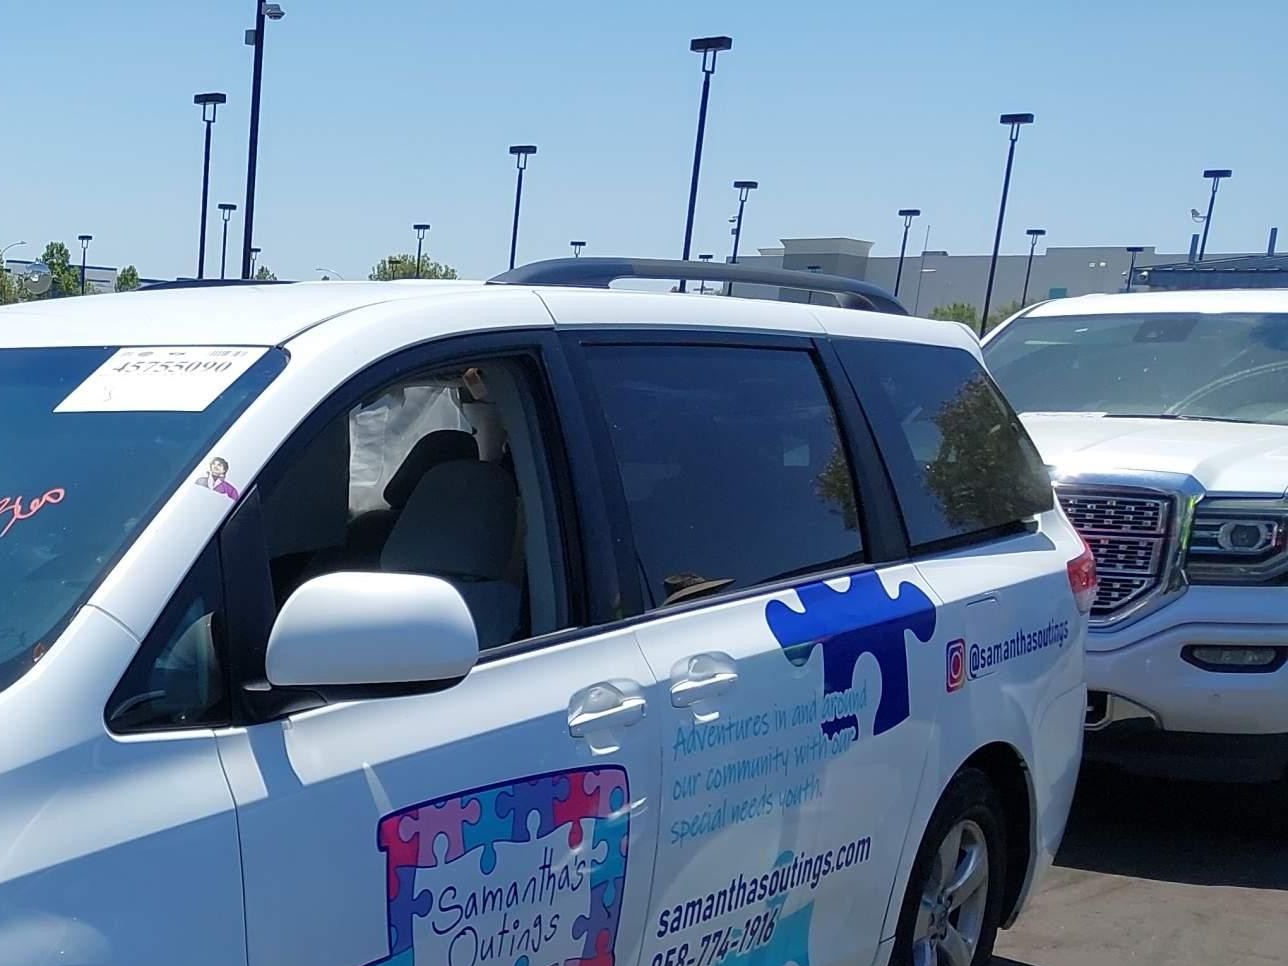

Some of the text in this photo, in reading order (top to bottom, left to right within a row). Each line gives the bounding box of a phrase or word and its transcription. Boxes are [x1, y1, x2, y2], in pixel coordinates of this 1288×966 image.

[113, 361, 232, 373] 45755090
[969, 618, 1069, 679] @samanthasoutings
[673, 680, 867, 761] Adventures in and around
[672, 728, 854, 800] our community with our
[670, 774, 823, 845] special needs youth.
[432, 846, 586, 935] Samantha's
[656, 835, 871, 939] samanthasoutings.com
